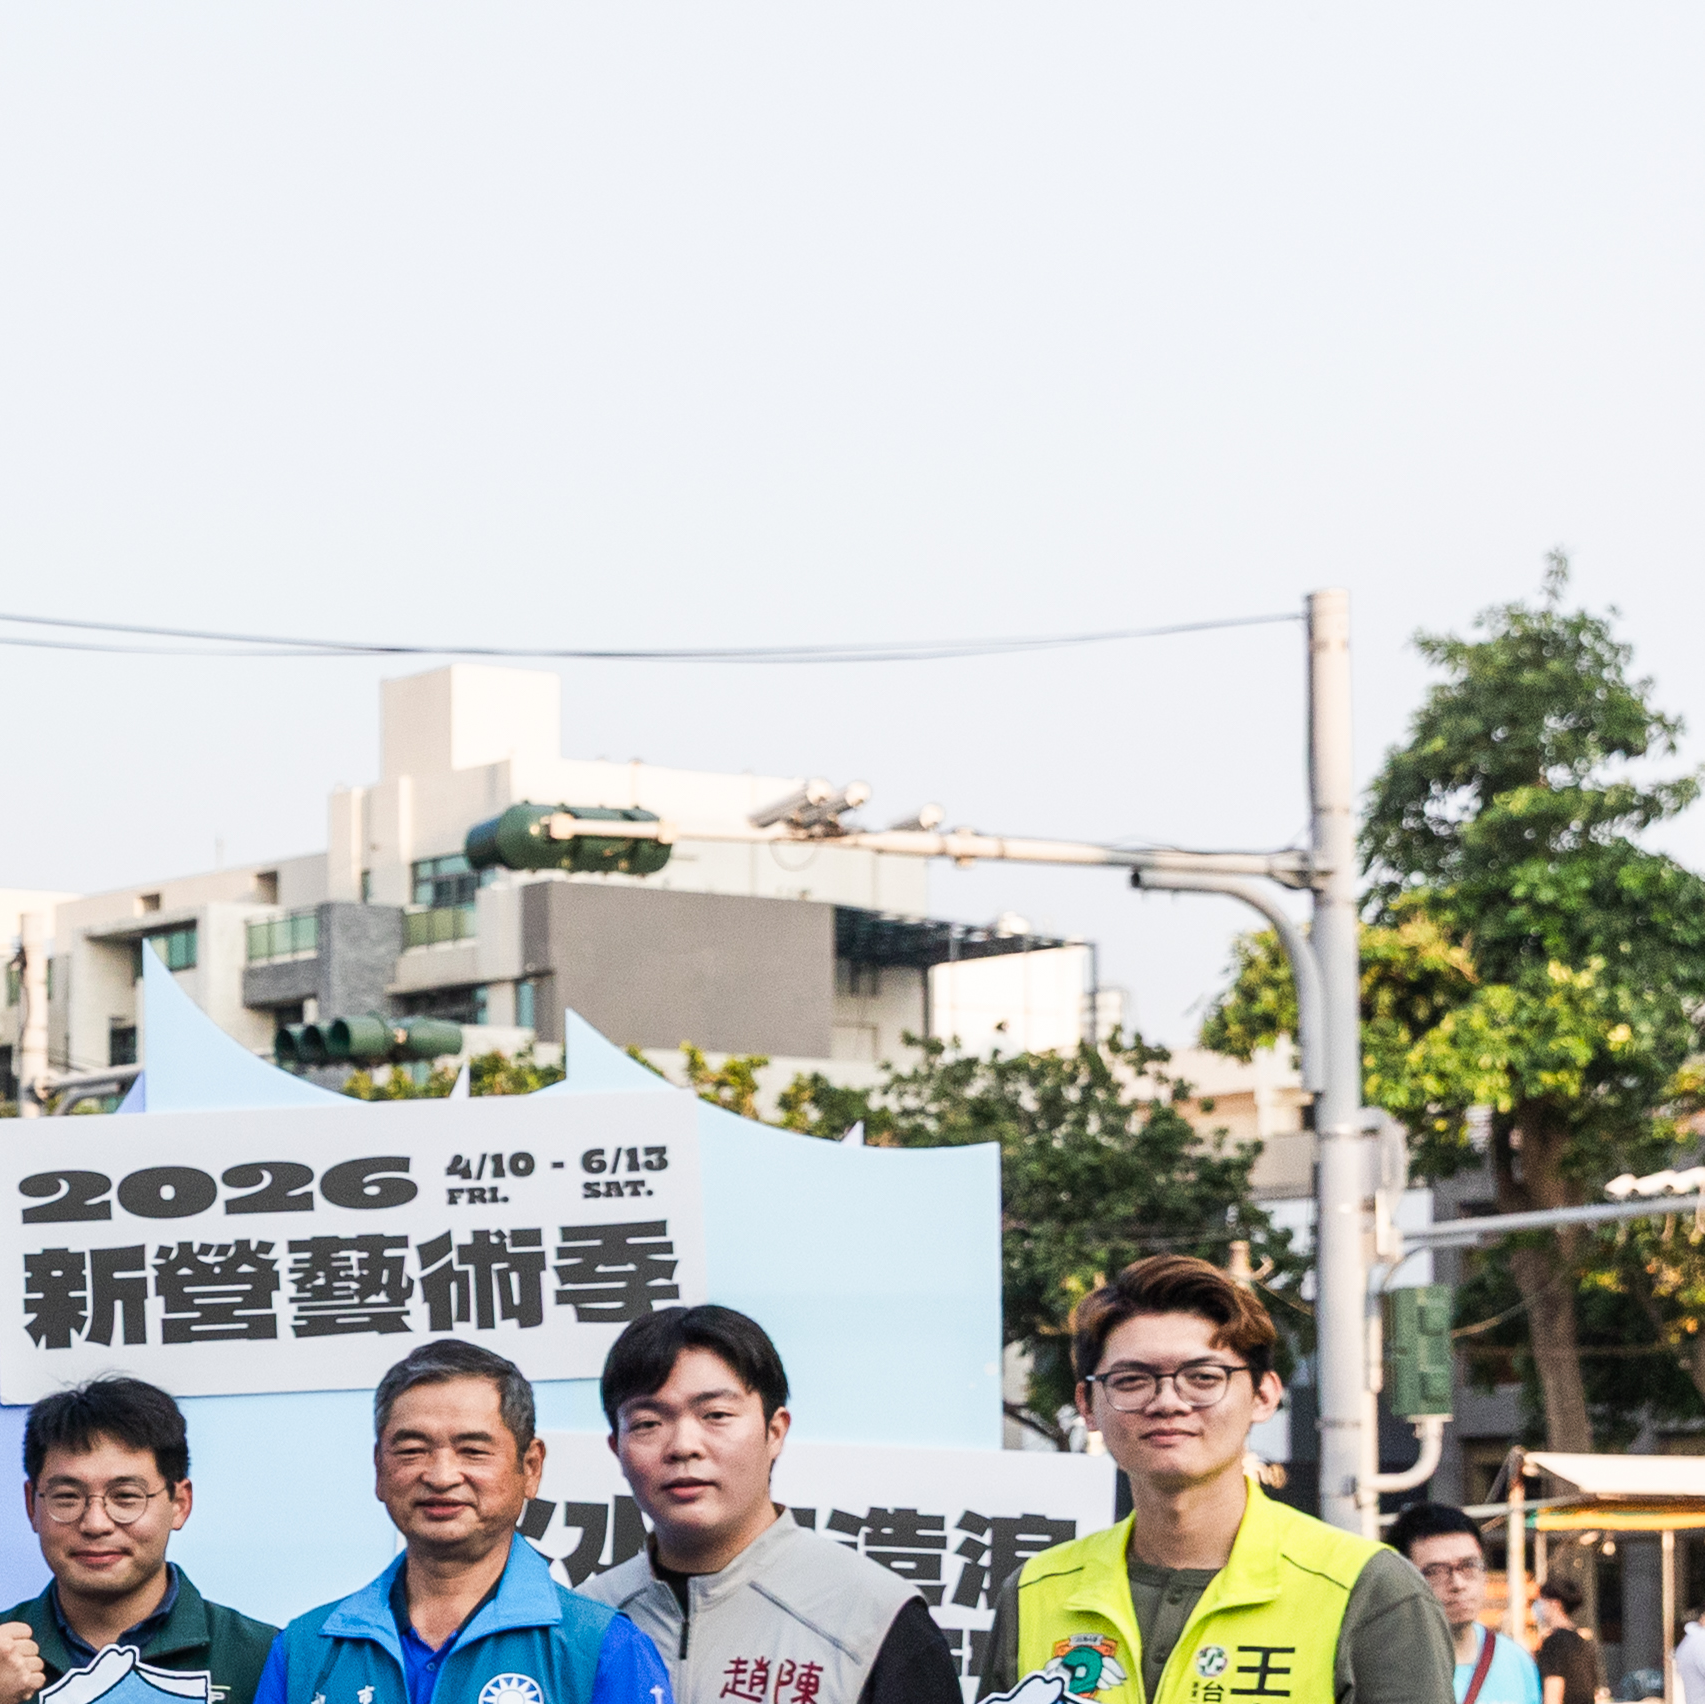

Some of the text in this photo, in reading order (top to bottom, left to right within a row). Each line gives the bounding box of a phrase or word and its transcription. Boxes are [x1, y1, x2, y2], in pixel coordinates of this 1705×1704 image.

[446, 1150, 535, 1180] 4/10
[581, 1145, 668, 1175] 6/13
[18, 1156, 418, 1224] 2026
[447, 1180, 653, 1205] FRI. SAT.
[23, 1219, 680, 1349] 新營藝術季
